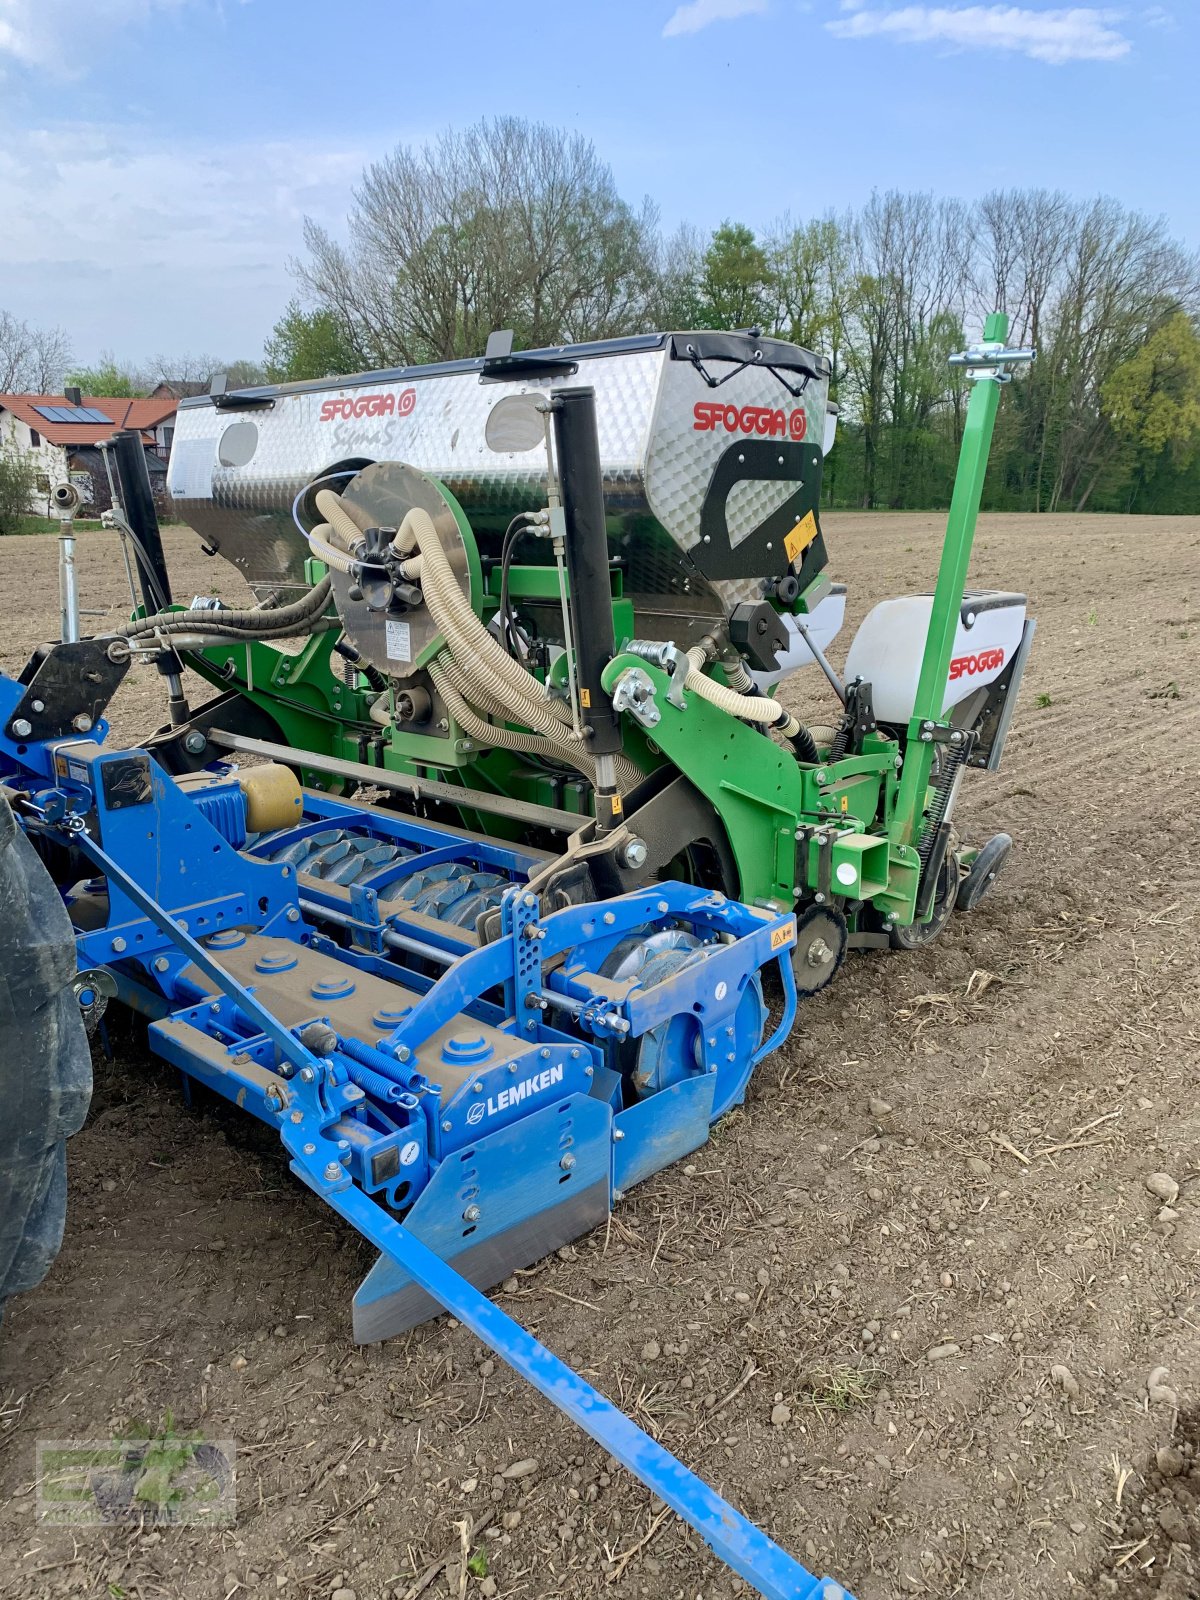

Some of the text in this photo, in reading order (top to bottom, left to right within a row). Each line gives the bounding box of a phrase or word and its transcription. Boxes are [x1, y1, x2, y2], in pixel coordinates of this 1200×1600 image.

[320, 393, 396, 421] SFOGGIA
[693, 402, 786, 436] SFOGGIA
[949, 648, 1004, 680] SFOGGIA
[487, 1063, 563, 1116] LEMKEN
